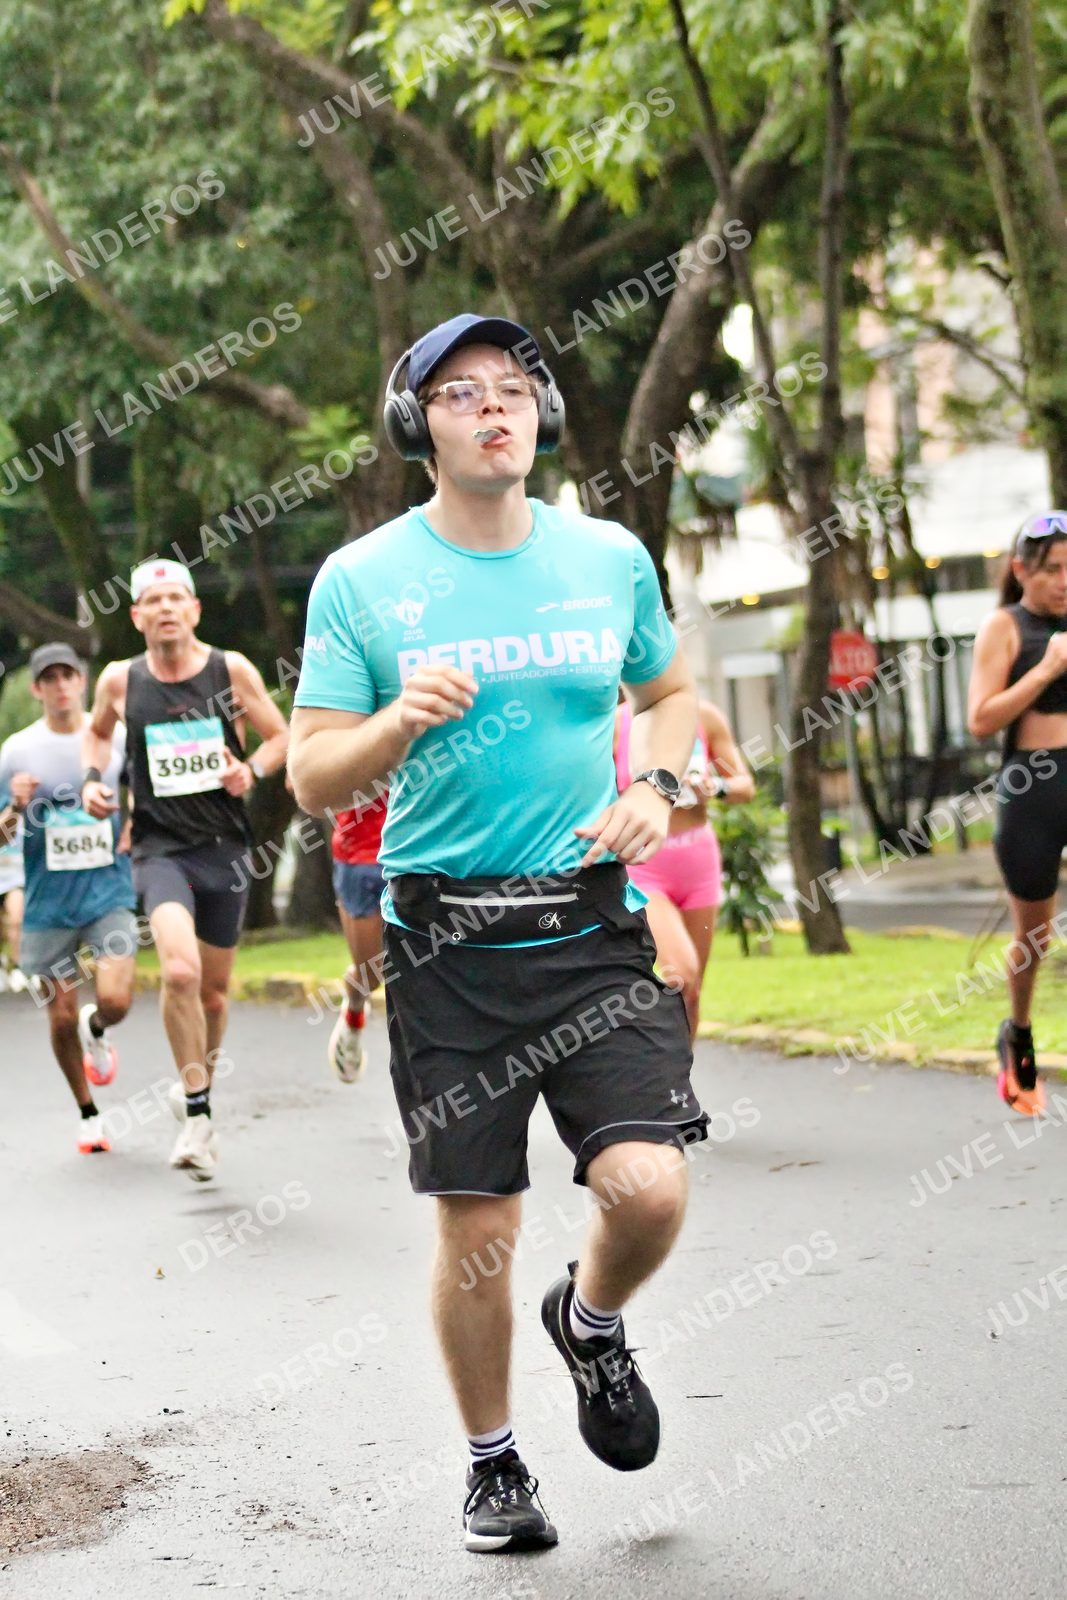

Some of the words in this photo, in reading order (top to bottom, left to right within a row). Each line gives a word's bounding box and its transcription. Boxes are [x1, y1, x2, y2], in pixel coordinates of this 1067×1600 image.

[563, 596, 613, 611] BROOKS
[397, 627, 622, 686] PERDURA
[488, 666, 568, 684] JUNTEADORES
[156, 752, 220, 778] 3986
